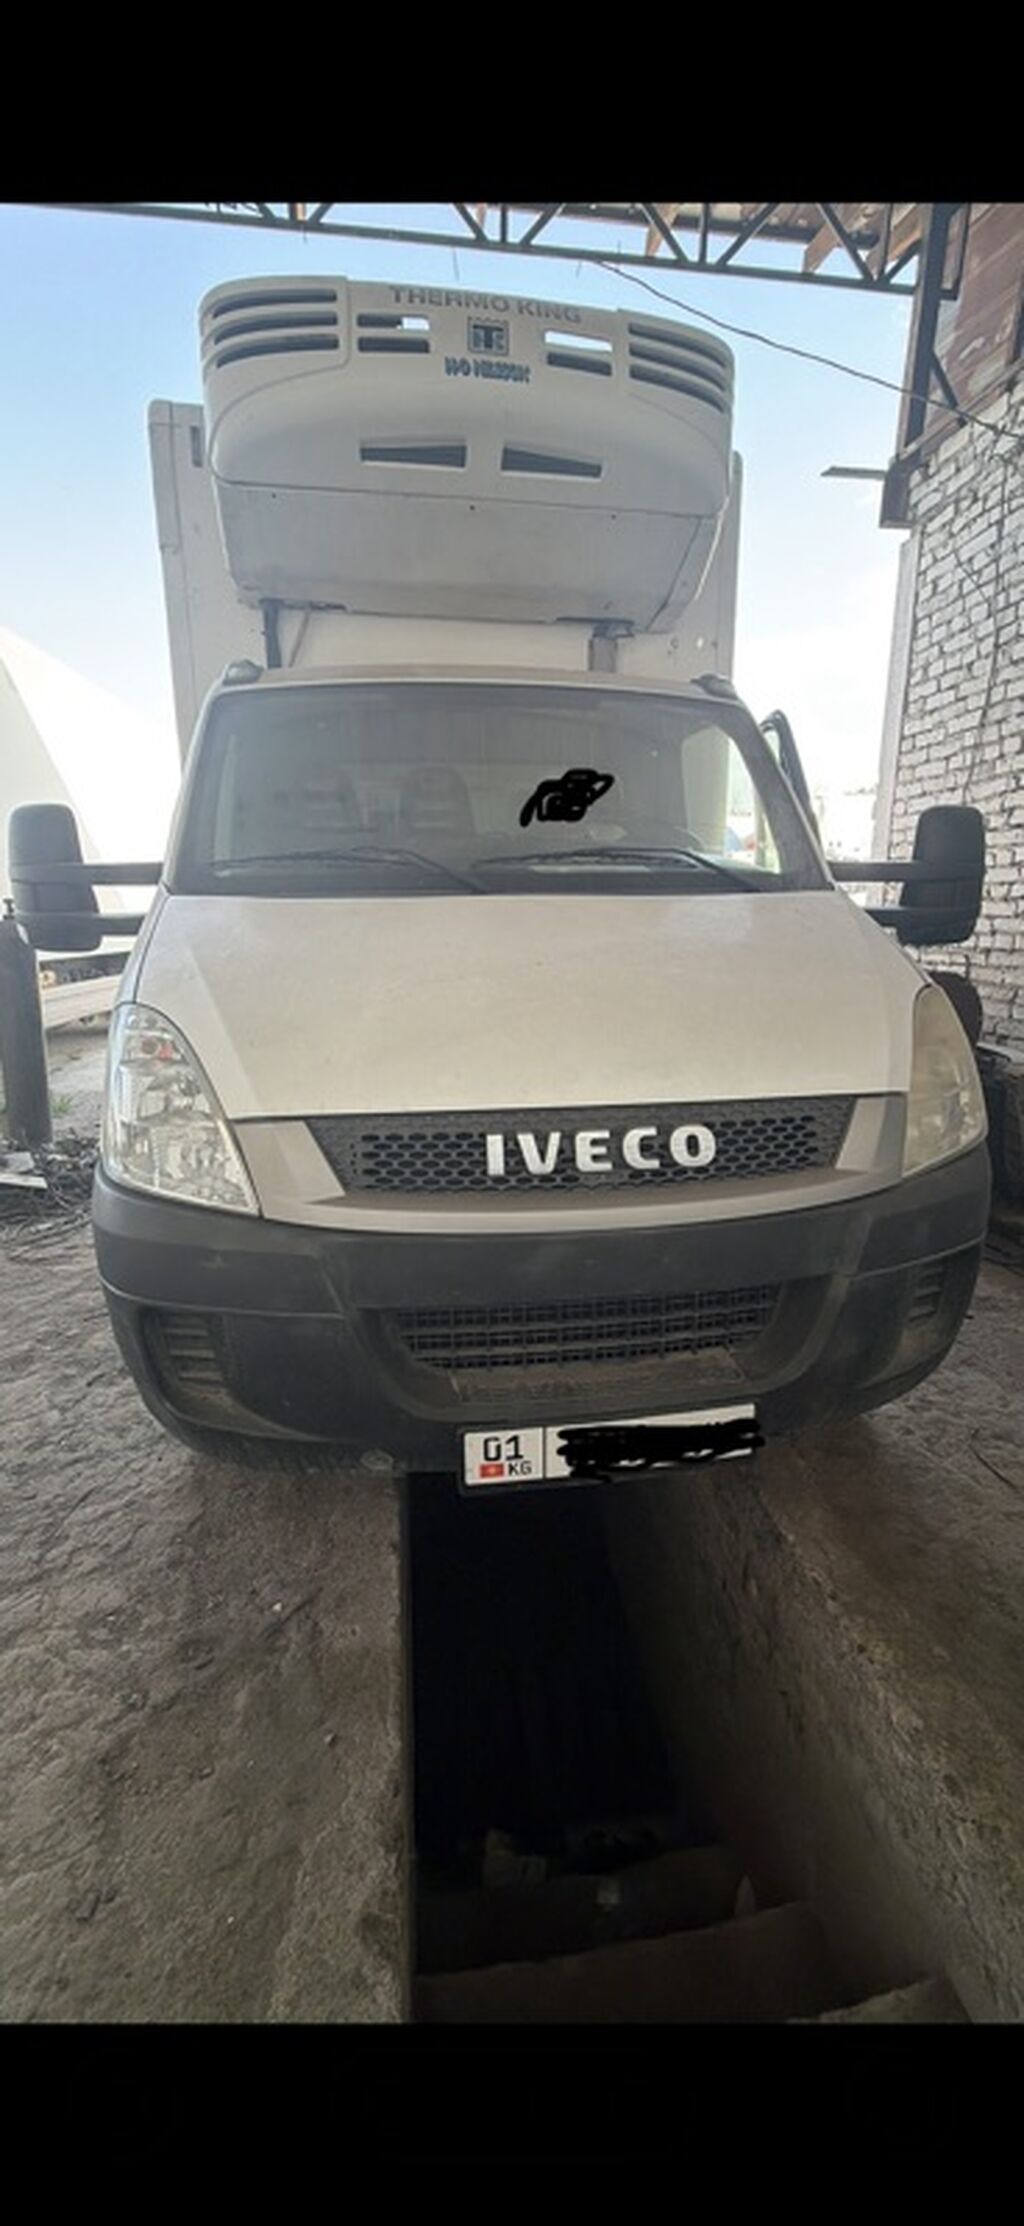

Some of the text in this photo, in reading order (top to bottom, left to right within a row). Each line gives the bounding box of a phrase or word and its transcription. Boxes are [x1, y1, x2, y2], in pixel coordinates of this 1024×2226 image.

[389, 286, 582, 323] THERMO KING
[486, 1124, 717, 1176] IVECO
[483, 1434, 525, 1462] 01
[507, 1460, 532, 1476] KG
